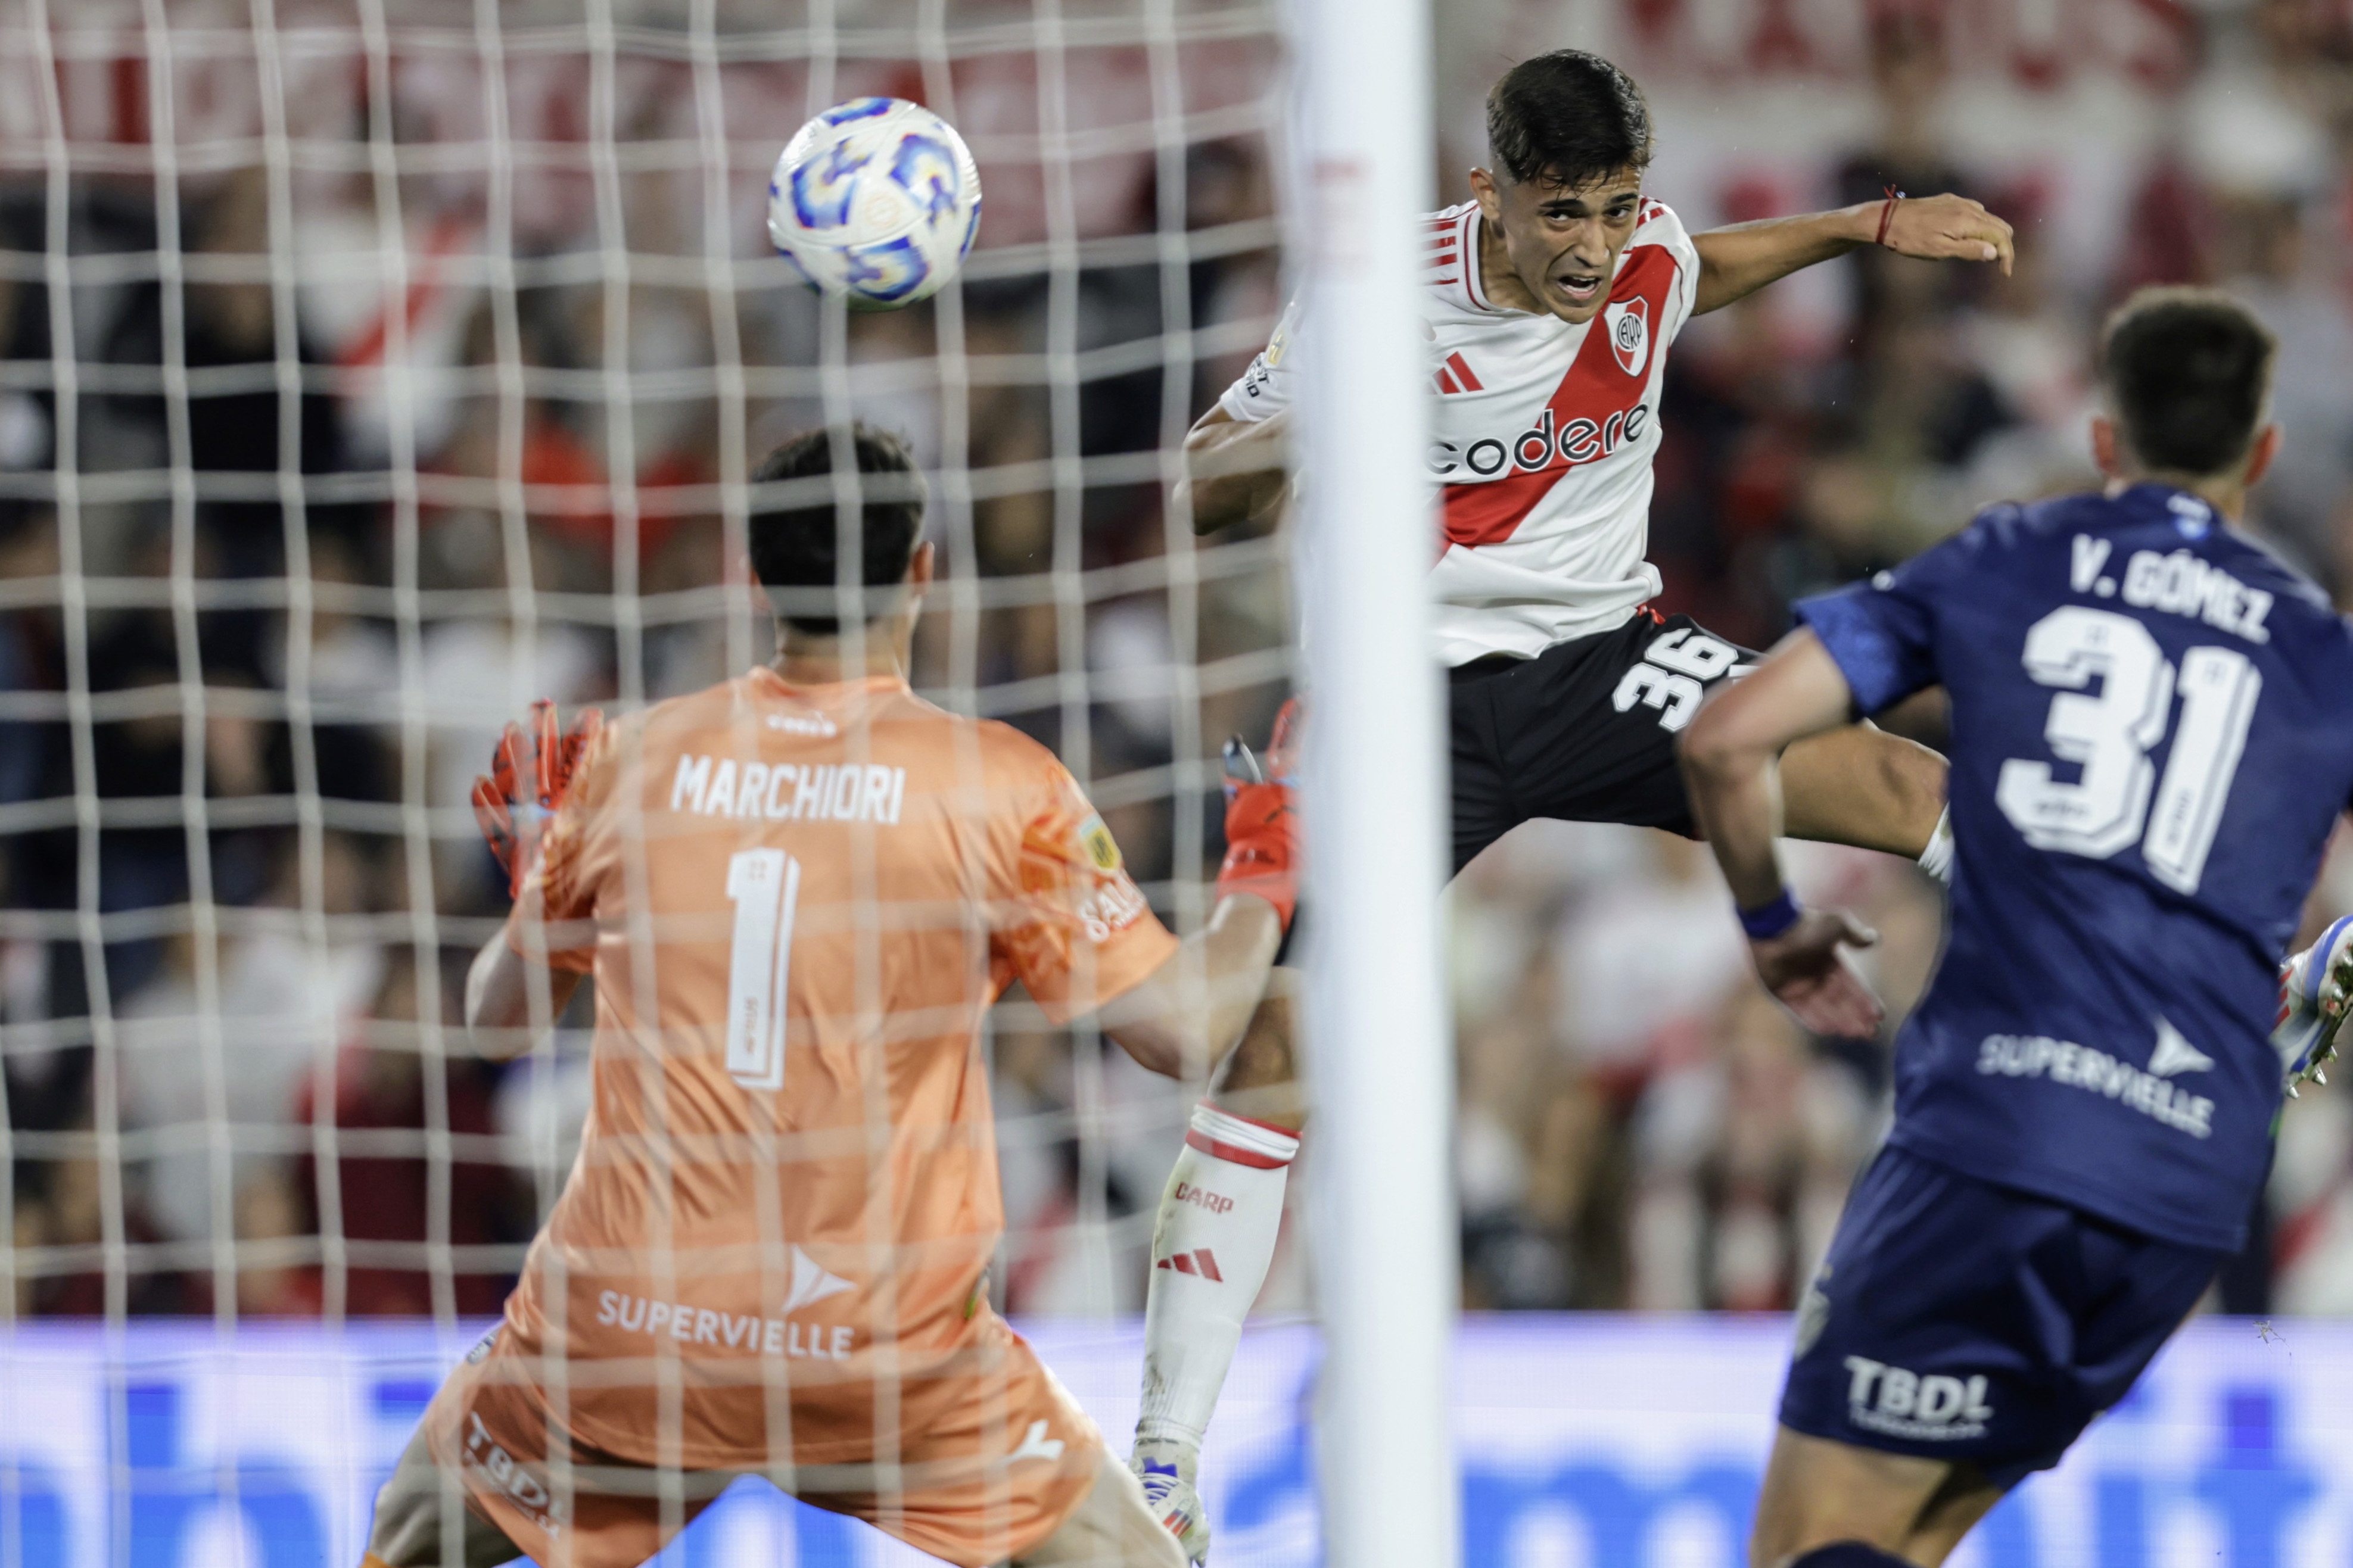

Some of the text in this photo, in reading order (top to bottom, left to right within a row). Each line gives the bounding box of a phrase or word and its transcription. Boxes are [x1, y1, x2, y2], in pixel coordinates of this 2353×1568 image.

[1426, 403, 1649, 476] codere
[2069, 533, 2274, 645] V. GÓMEZ
[1612, 628, 1739, 733] 36
[671, 753, 906, 825] MARCHIORI
[1995, 604, 2264, 897] 31
[725, 847, 801, 1090] 1
[1975, 1034, 2216, 1139] SUPERVIELLE
[1175, 1182, 1234, 1214] CARP
[596, 1289, 854, 1361] SUPERVIELLE
[1842, 1354, 1993, 1423] TBDL
